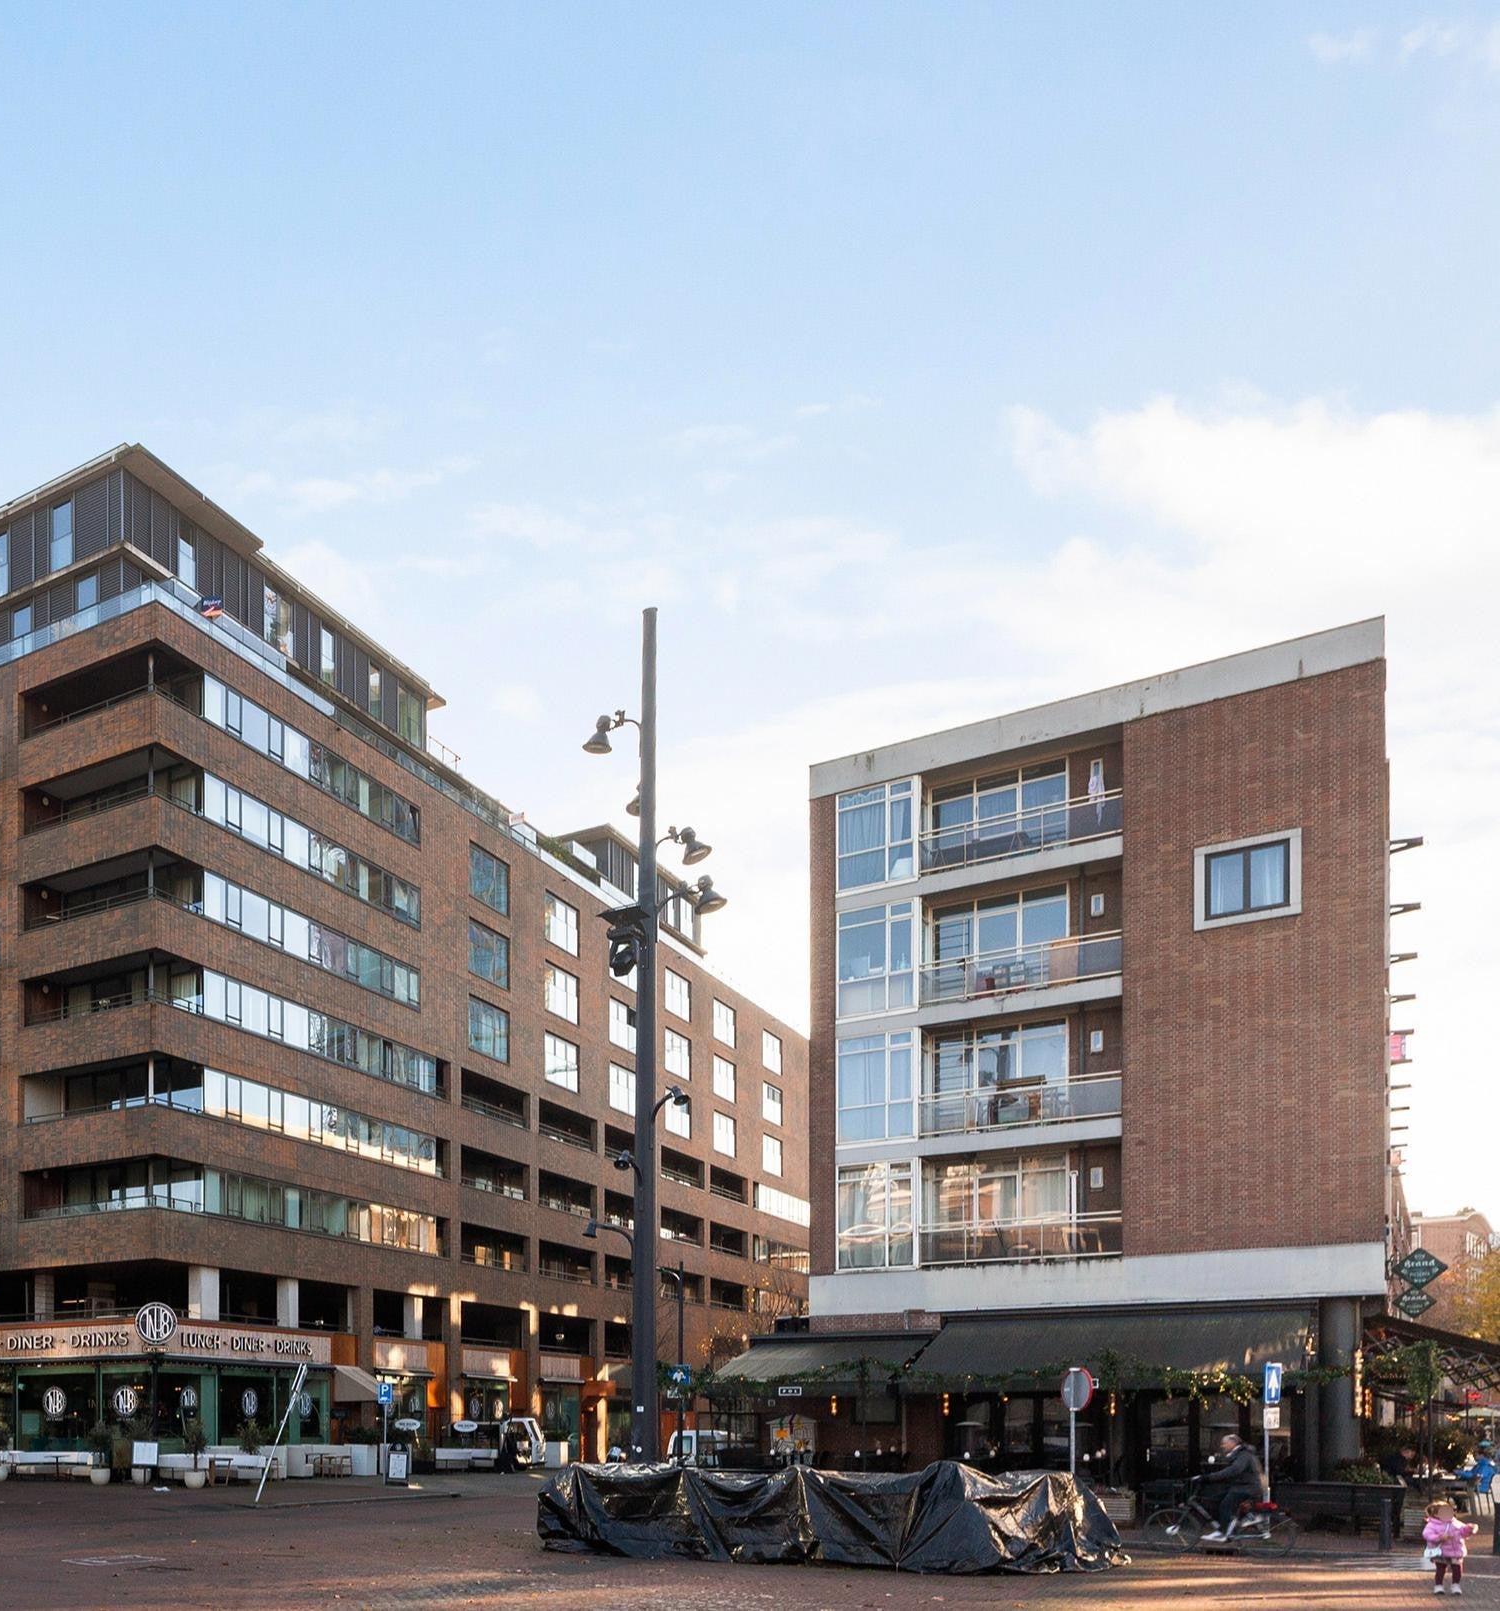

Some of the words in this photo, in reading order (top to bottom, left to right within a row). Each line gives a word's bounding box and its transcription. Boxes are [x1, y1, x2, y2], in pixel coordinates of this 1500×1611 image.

[7, 1335, 54, 1350] DINER
[70, 1332, 129, 1348] DRINKS
[181, 1333, 221, 1350] LUNCH
[231, 1336, 266, 1353] DINER
[275, 1339, 313, 1356] DRINKS
[381, 1385, 390, 1394] P
